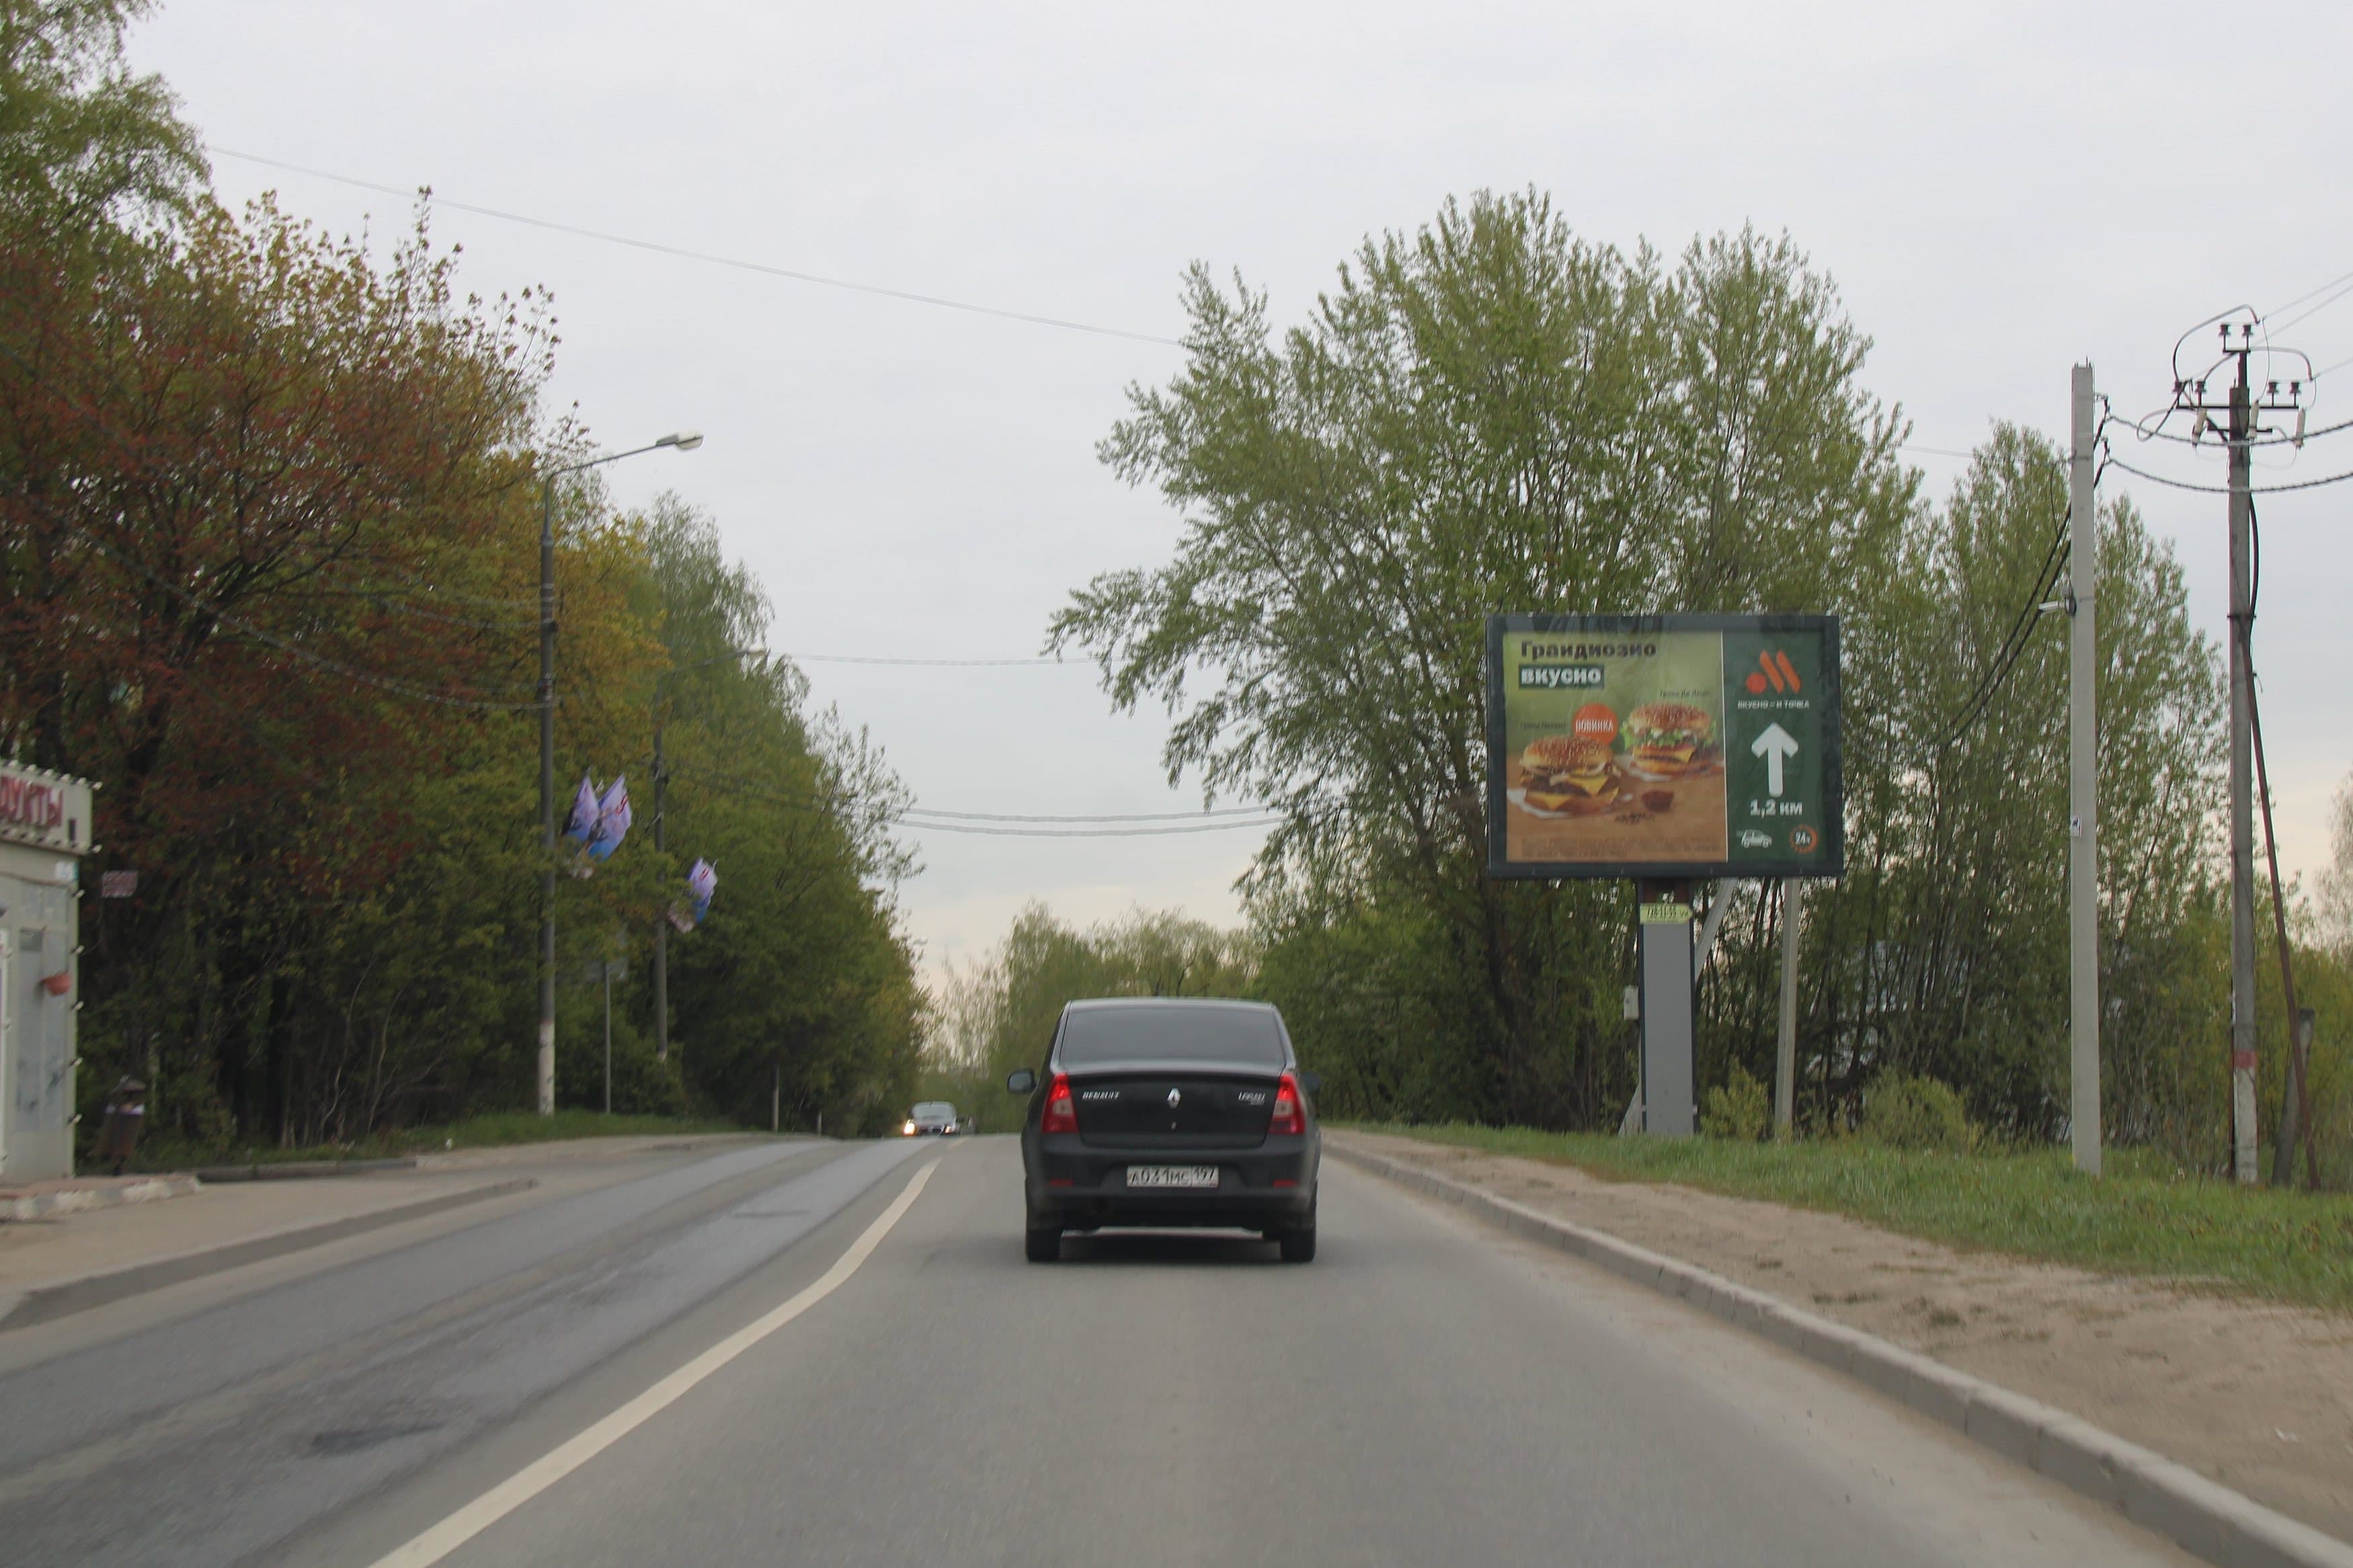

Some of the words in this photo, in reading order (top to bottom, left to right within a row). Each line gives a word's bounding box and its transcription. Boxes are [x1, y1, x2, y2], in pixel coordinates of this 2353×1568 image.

[1521, 640, 1657, 661] Грандиозно
[1521, 667, 1602, 688] вкусно
[1576, 719, 1613, 732] НОВИНКА
[1750, 798, 1776, 819] 1,2
